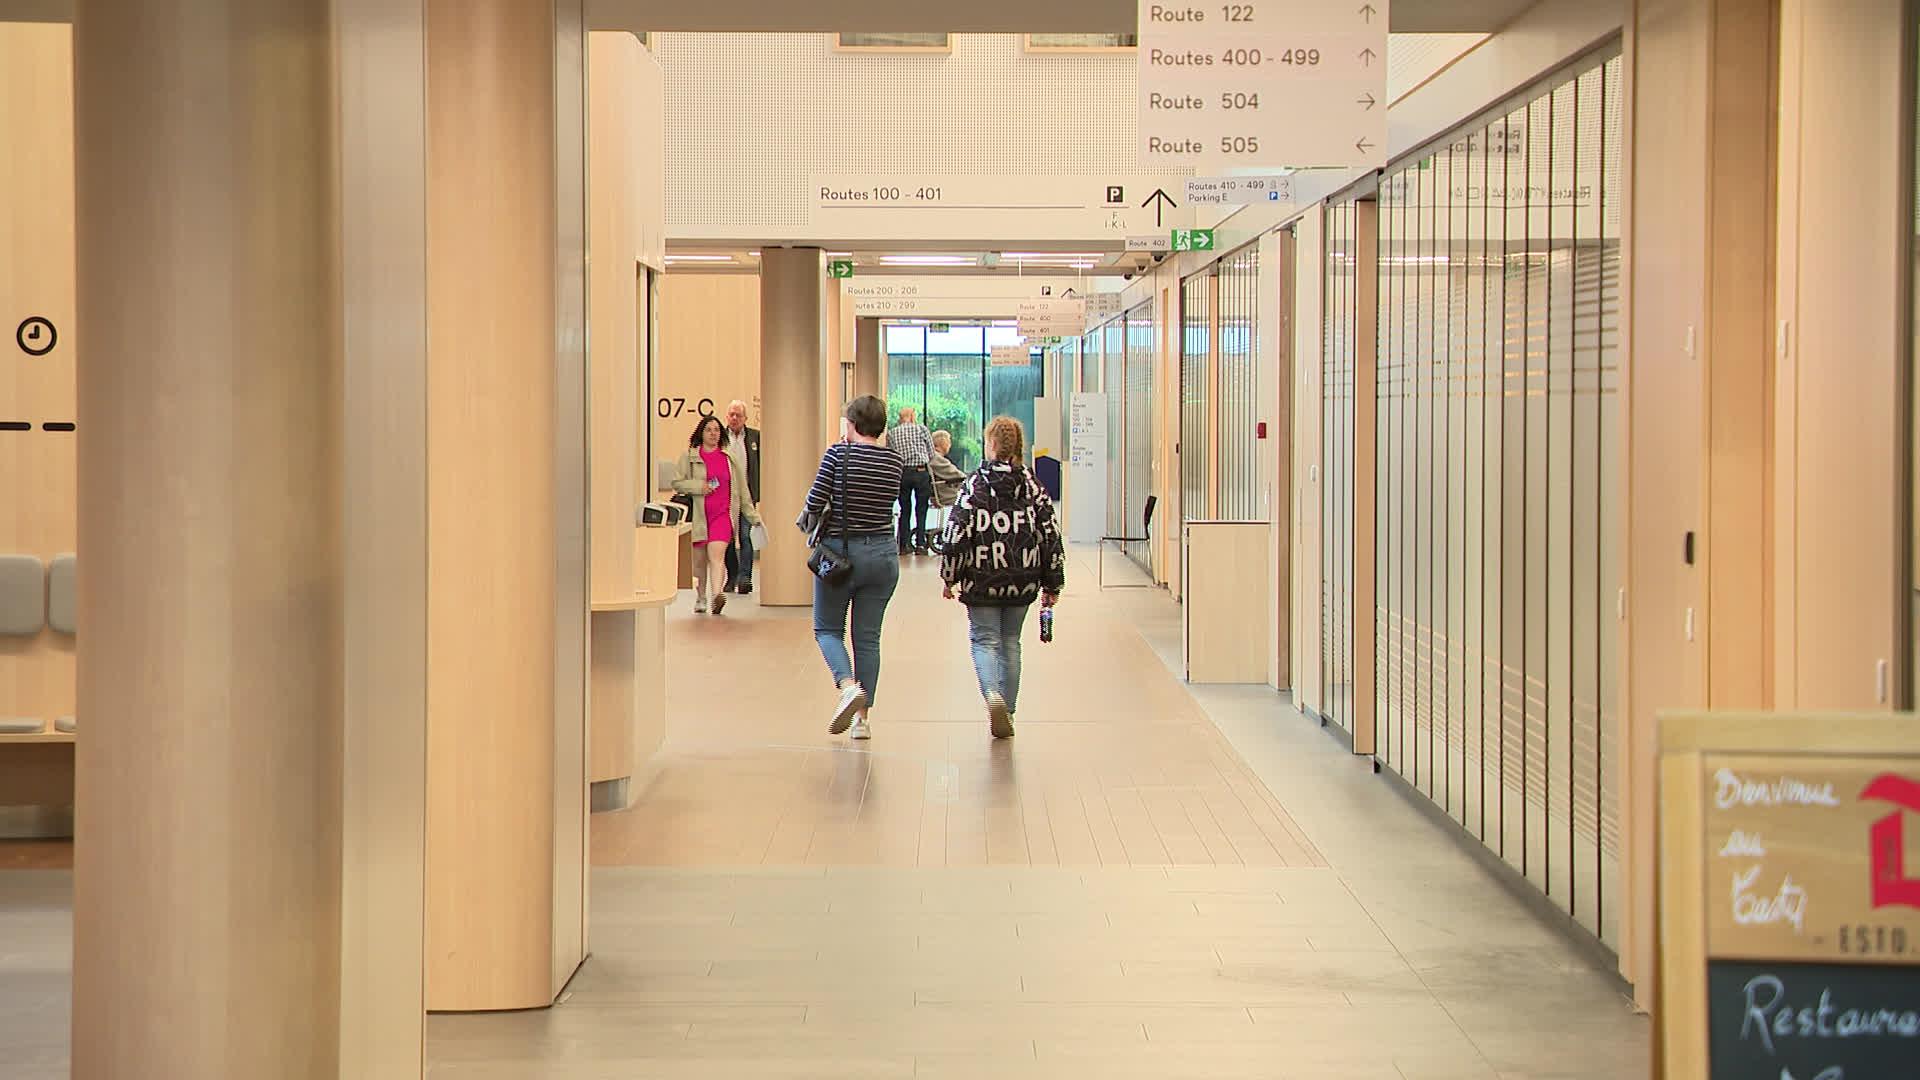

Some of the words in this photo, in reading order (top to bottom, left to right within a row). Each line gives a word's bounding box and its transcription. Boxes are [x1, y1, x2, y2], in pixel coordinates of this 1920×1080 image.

[1150, 5, 1204, 22] Route
[1221, 5, 1254, 22] 122
[1150, 49, 1213, 66] Routes
[1221, 49, 1261, 65] 400
[1281, 49, 1320, 65] 499
[1150, 92, 1204, 109] Route
[1221, 92, 1259, 109] 504
[1149, 136, 1203, 153] Route
[1221, 136, 1259, 153] 505
[1188, 182, 1218, 190] Routes
[1220, 182, 1236, 190] 410
[1247, 181, 1265, 189] 499
[820, 186, 869, 201] Routes
[872, 186, 900, 201] 100
[915, 187, 942, 201] 401
[1188, 193, 1220, 203] Parking
[1222, 193, 1228, 201] E
[847, 286, 875, 295] Routes
[877, 286, 893, 295] 200
[855, 302, 875, 310] utes
